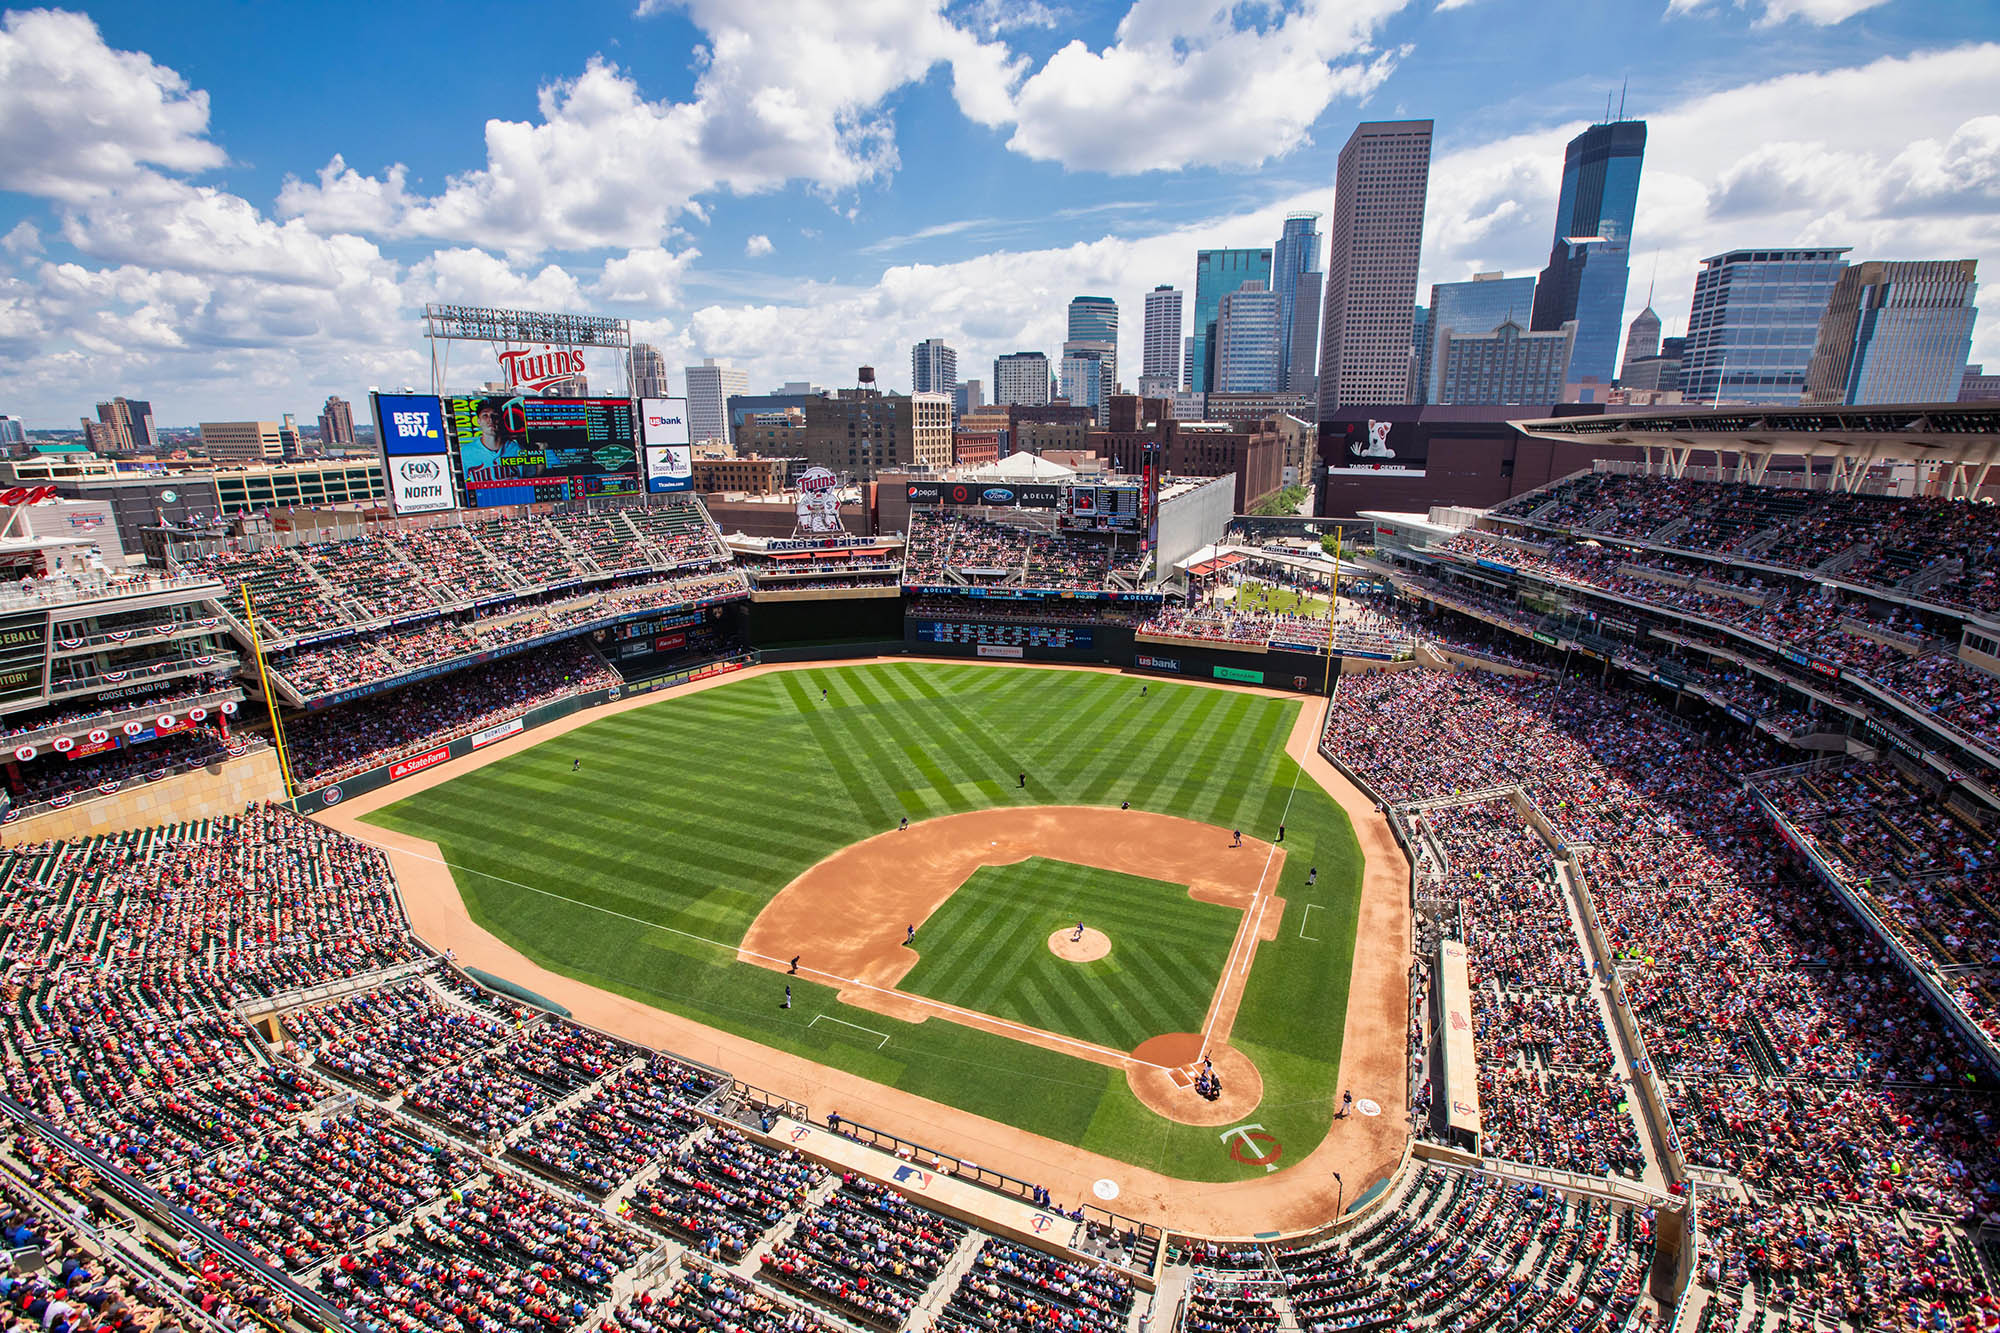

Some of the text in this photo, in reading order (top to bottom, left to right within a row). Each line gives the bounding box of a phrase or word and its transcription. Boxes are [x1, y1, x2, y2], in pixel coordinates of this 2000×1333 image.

[498, 344, 586, 388] Twins
[393, 412, 429, 424] BEST
[398, 424, 428, 437] BUY
[501, 456, 545, 466] KEPLER
[408, 463, 431, 474] FOX
[797, 474, 837, 494] Twins
[405, 485, 442, 499] NORTH
[918, 489, 938, 497] pepsi
[767, 537, 877, 550] TARGET FIELD
[501, 643, 524, 654] DELTA
[97, 680, 170, 702] GOOSE ISLAND PUB
[344, 687, 376, 700] DELTA
[384, 677, 407, 689] ENDLESS
[128, 724, 139, 733] 14
[484, 724, 511, 739] BUDWEISER
[1870, 721, 1887, 737] DELTA
[92, 731, 106, 741] 34
[20, 748, 33, 758] 10
